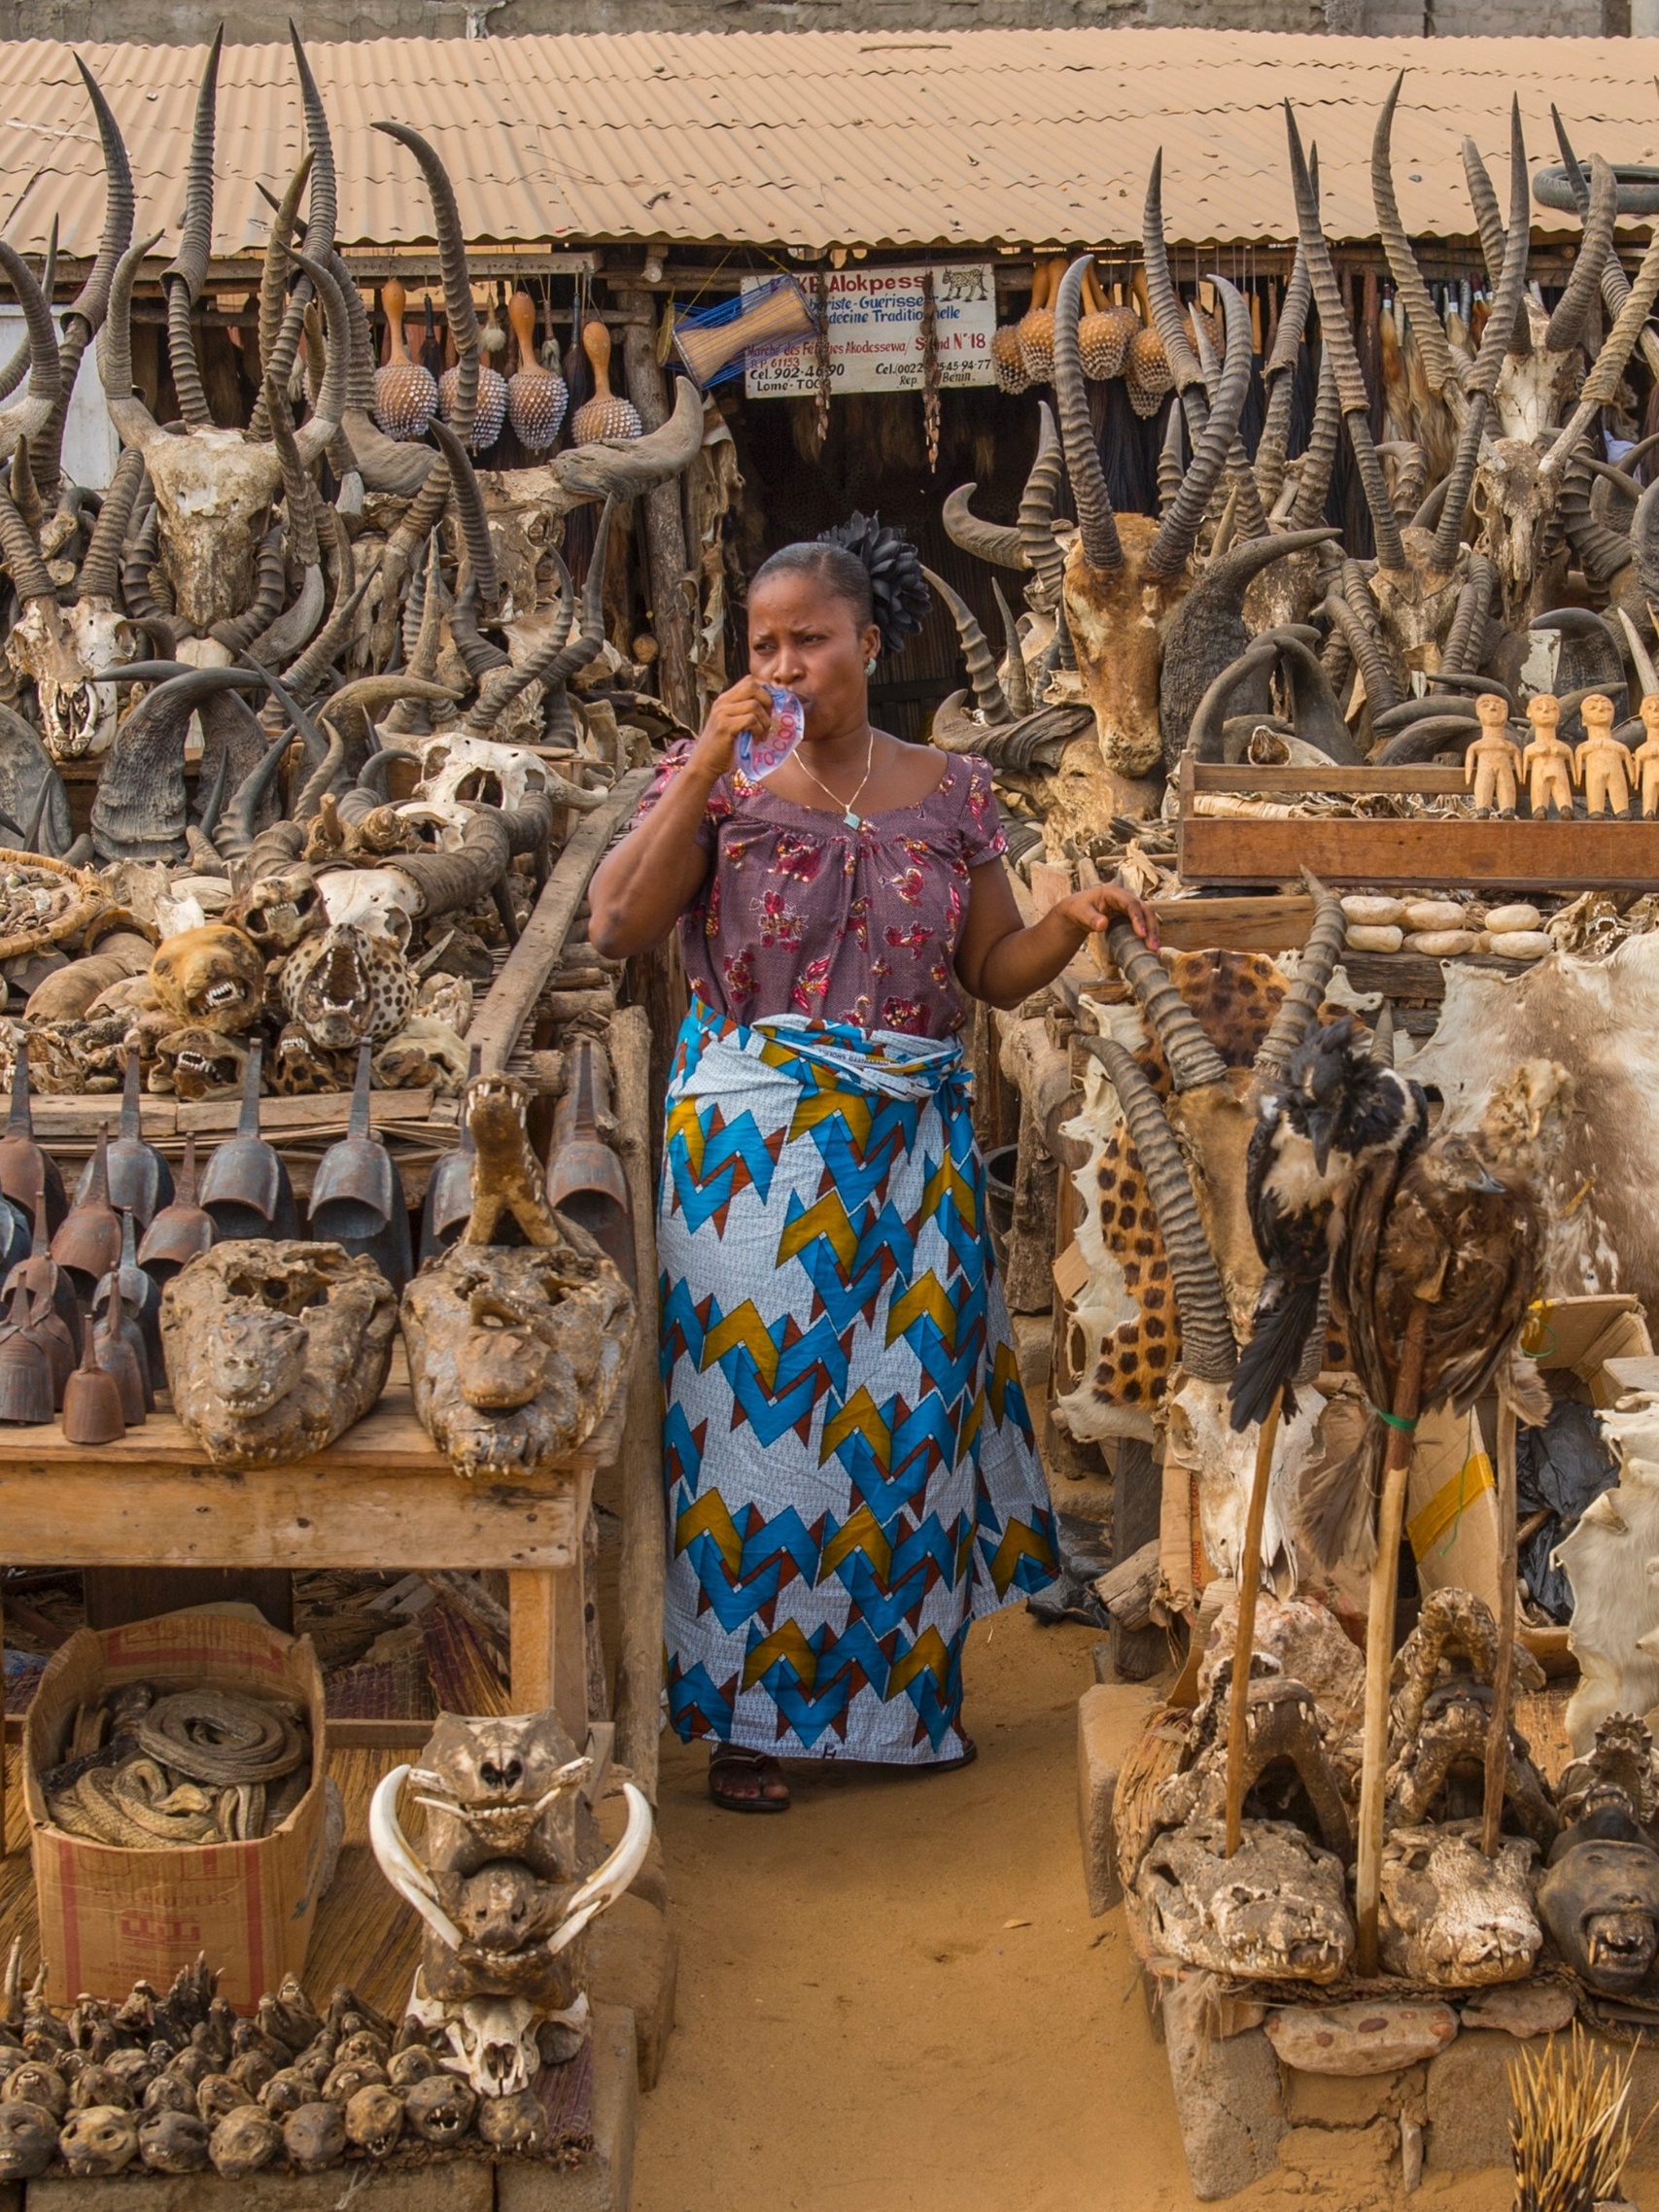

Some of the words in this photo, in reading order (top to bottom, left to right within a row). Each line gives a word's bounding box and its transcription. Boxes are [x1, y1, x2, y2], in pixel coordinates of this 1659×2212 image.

[828, 309, 869, 325] décine
[872, 305, 960, 323] Traditionelle
[915, 335, 950, 351] Snd
[771, 357, 800, 368] 61153
